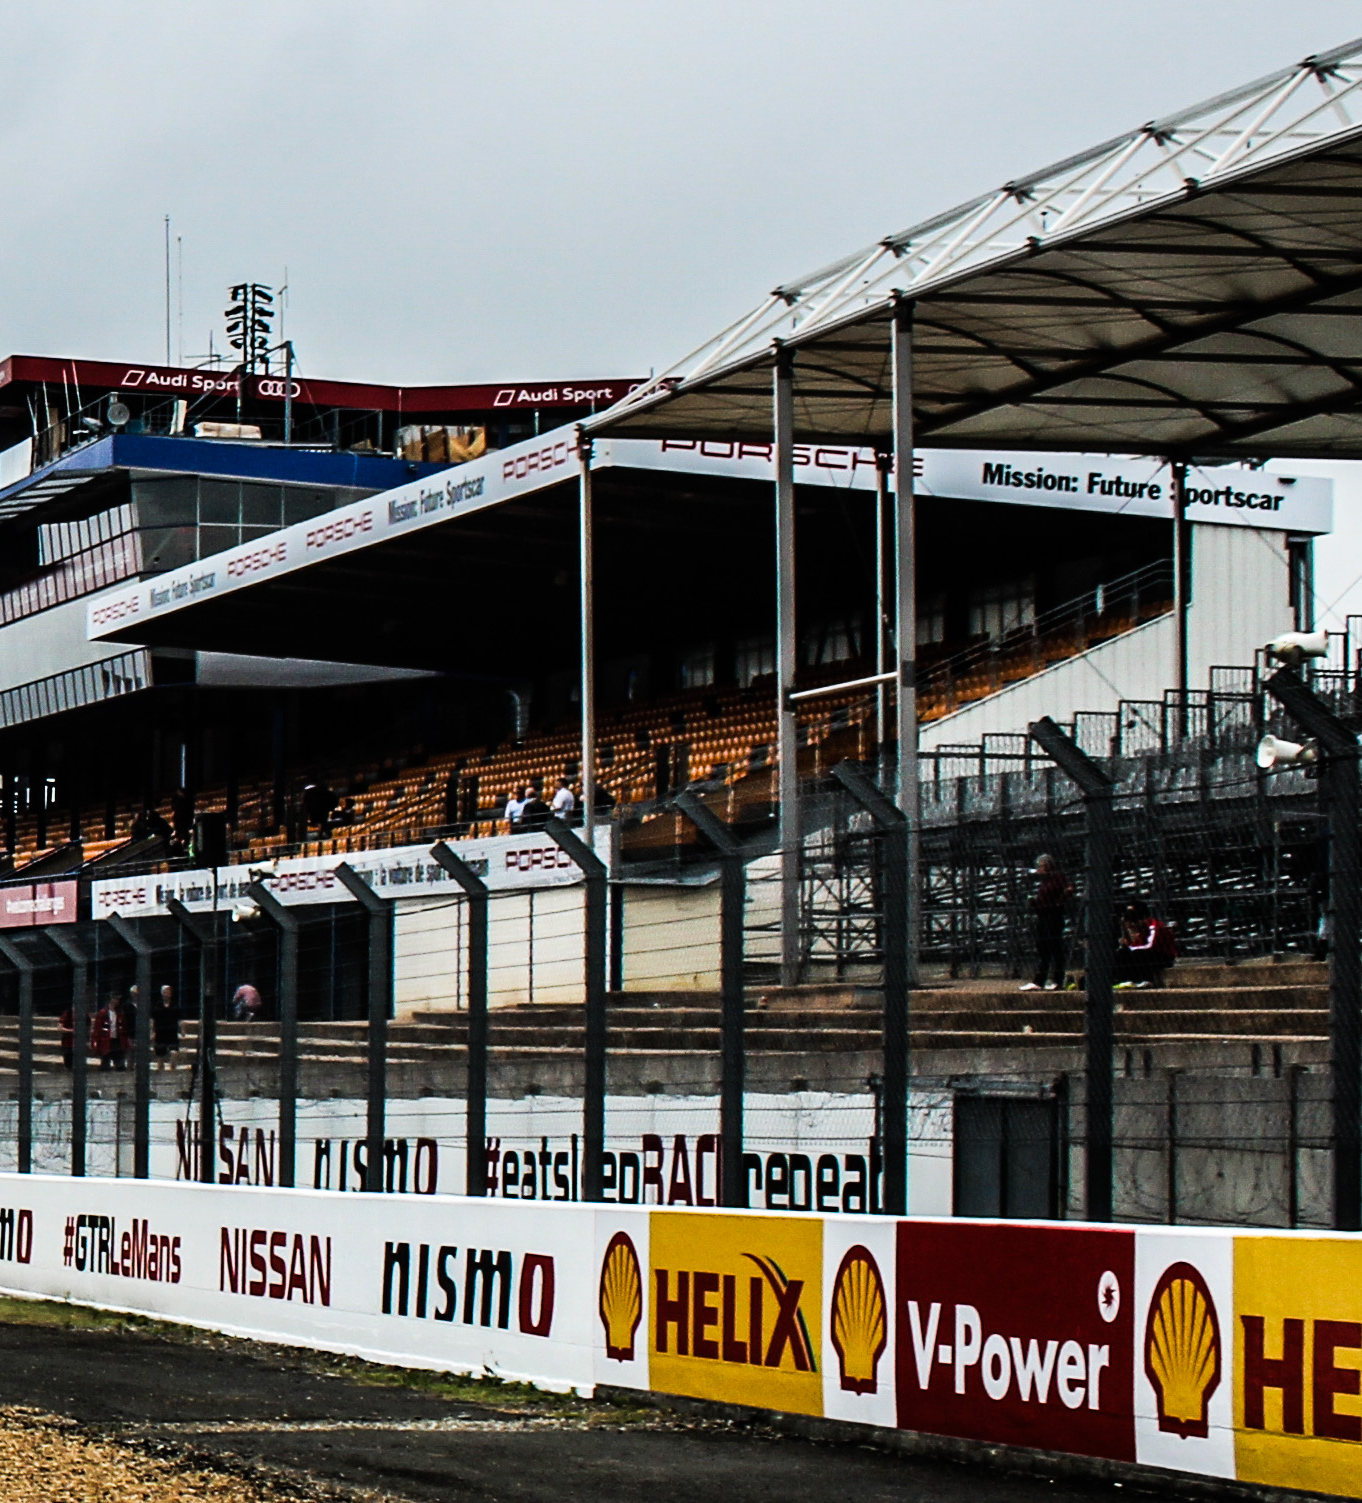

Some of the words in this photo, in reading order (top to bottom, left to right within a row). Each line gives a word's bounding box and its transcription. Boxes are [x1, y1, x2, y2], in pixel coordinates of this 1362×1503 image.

[146, 372, 188, 387] Audi
[192, 375, 241, 391] Sport
[517, 388, 558, 403] Audi
[562, 387, 613, 402] Sport
[228, 542, 287, 578] PORSCHE
[307, 511, 373, 550] PORSCHE
[503, 441, 579, 483] PORSCH
[982, 462, 1078, 492] Mission:
[1087, 472, 1162, 500] Future
[505, 846, 572, 871] PORSC
[176, 1119, 275, 1187] NISAN
[64, 1213, 182, 1284] #GTRLeMans
[220, 1226, 332, 1307] NISSAN
[382, 1241, 555, 1337] nismo
[655, 1252, 818, 1373] HELIX
[907, 1300, 1110, 1411] V-Power
[1240, 1314, 1362, 1443] HE
